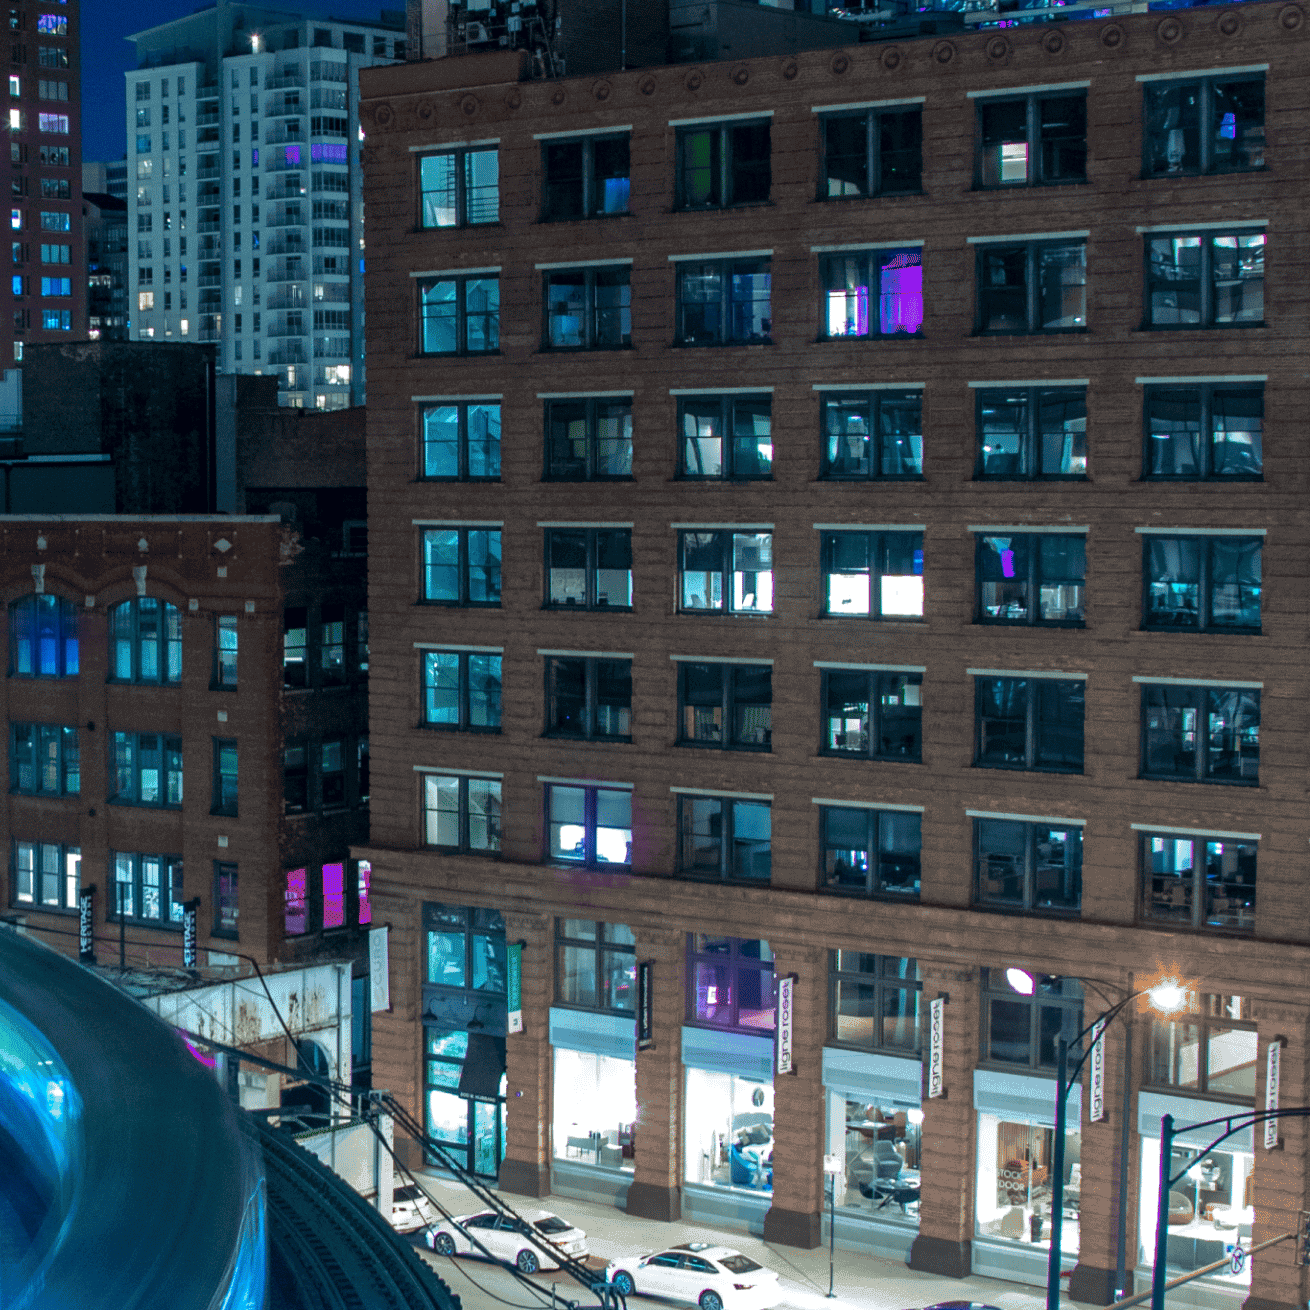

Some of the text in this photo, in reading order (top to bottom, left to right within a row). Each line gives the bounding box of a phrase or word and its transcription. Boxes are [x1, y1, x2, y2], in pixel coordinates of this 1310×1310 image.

[80, 896, 88, 953] HERITAGE
[780, 981, 791, 1071] ligne roset
[931, 1052, 941, 1095] ligne
[1092, 1021, 1103, 1118] ligne rost
